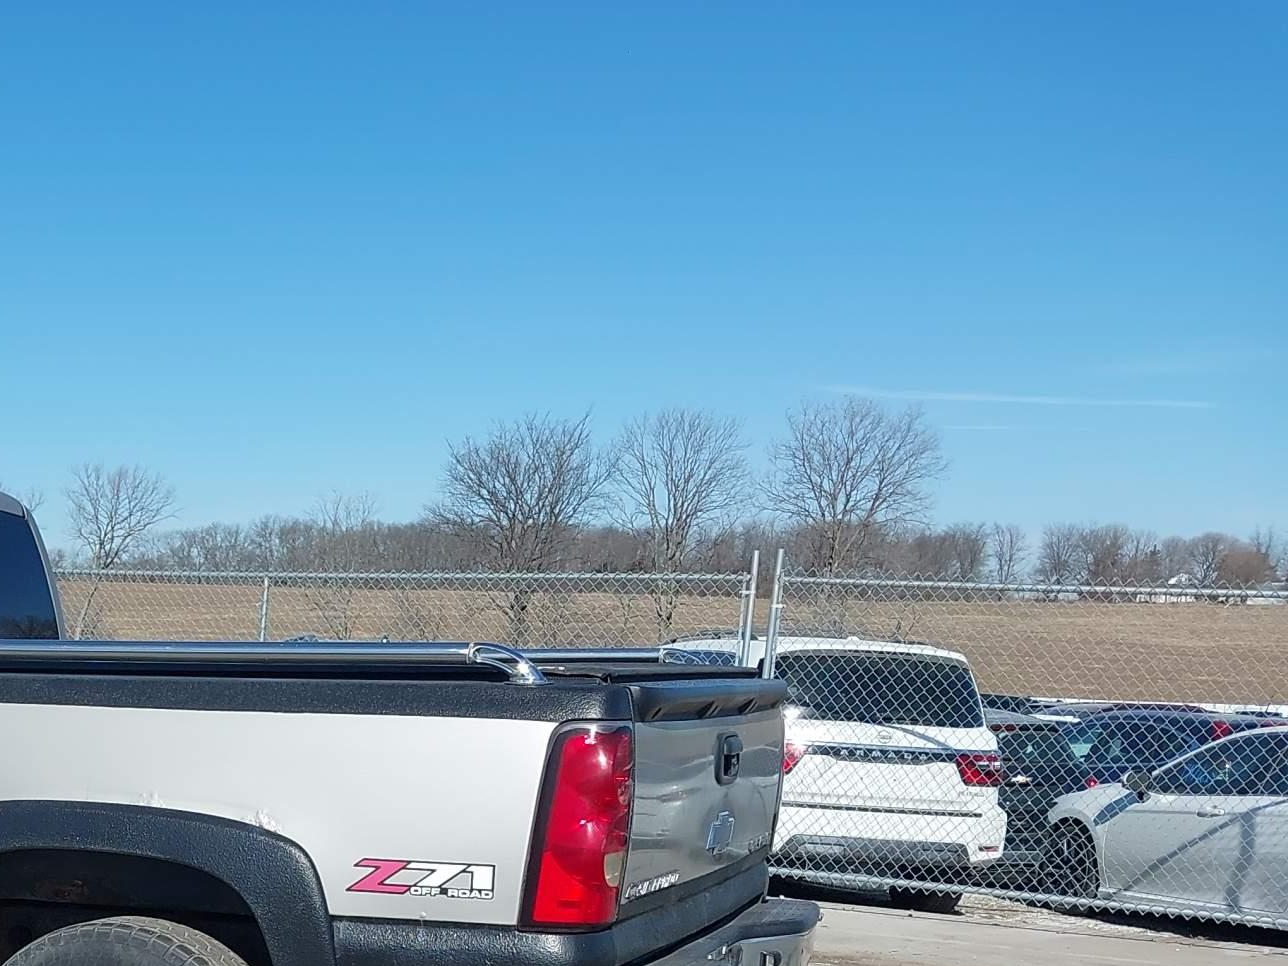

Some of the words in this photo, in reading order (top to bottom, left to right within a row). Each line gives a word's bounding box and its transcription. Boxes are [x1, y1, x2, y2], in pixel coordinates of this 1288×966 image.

[839, 748, 928, 761] ARMADA
[345, 857, 496, 895] Z71
[409, 886, 441, 896] OFF
[446, 887, 495, 899] ROAD
